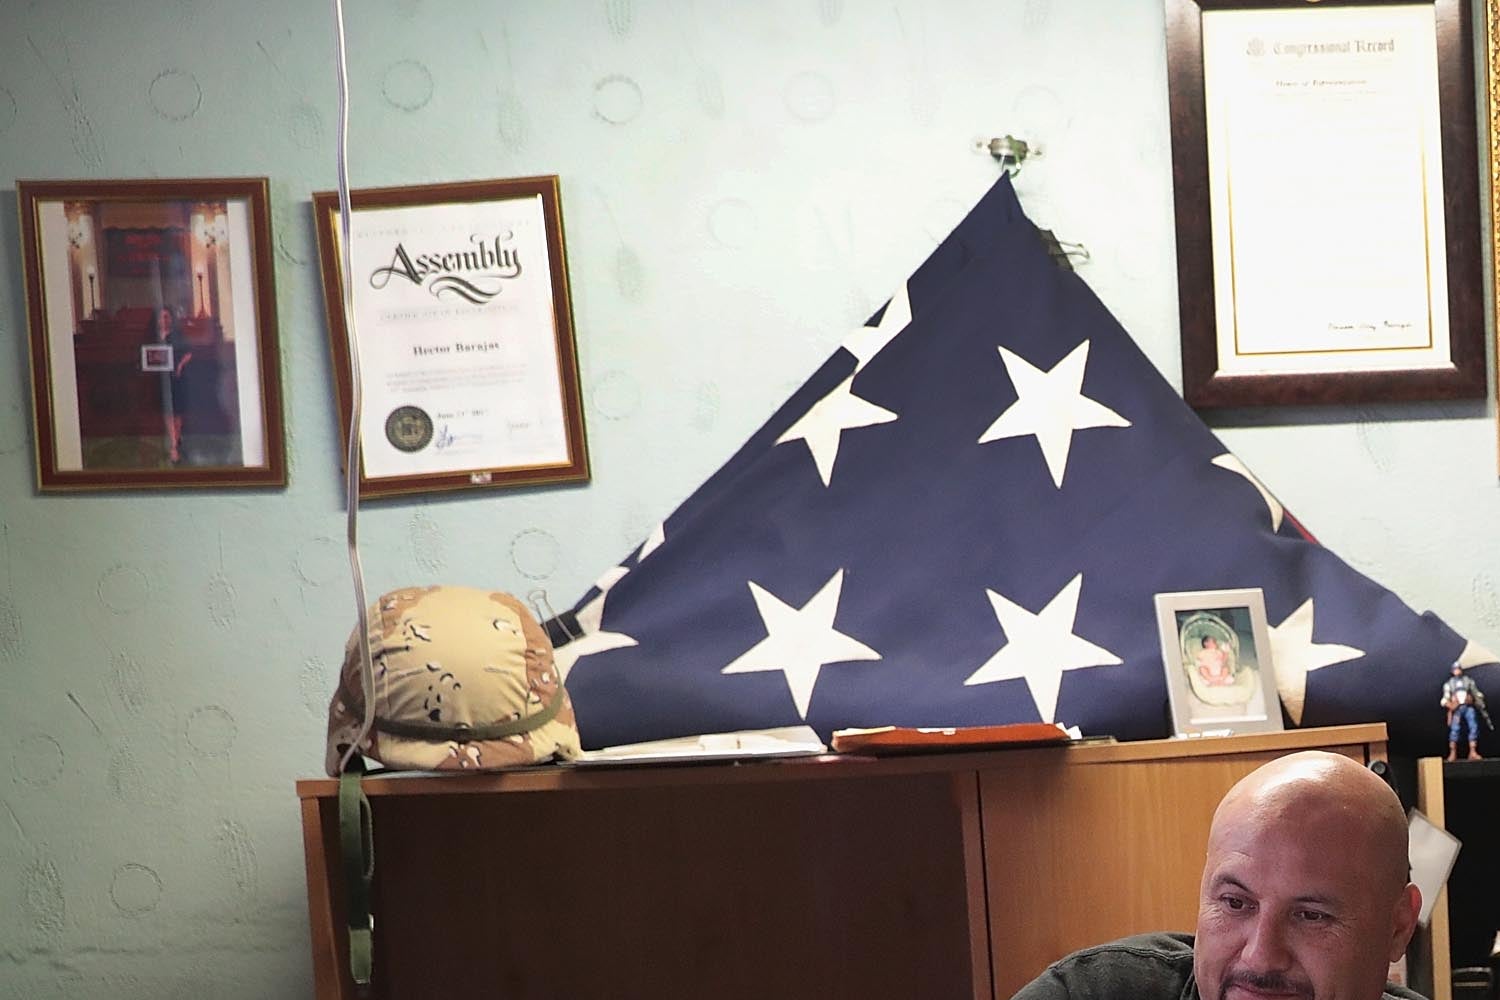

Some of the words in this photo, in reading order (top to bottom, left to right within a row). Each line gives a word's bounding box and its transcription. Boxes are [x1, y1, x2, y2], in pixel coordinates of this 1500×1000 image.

[1355, 38, 1395, 54] Record
[370, 230, 523, 290] Assembly
[413, 344, 450, 356] Hector
